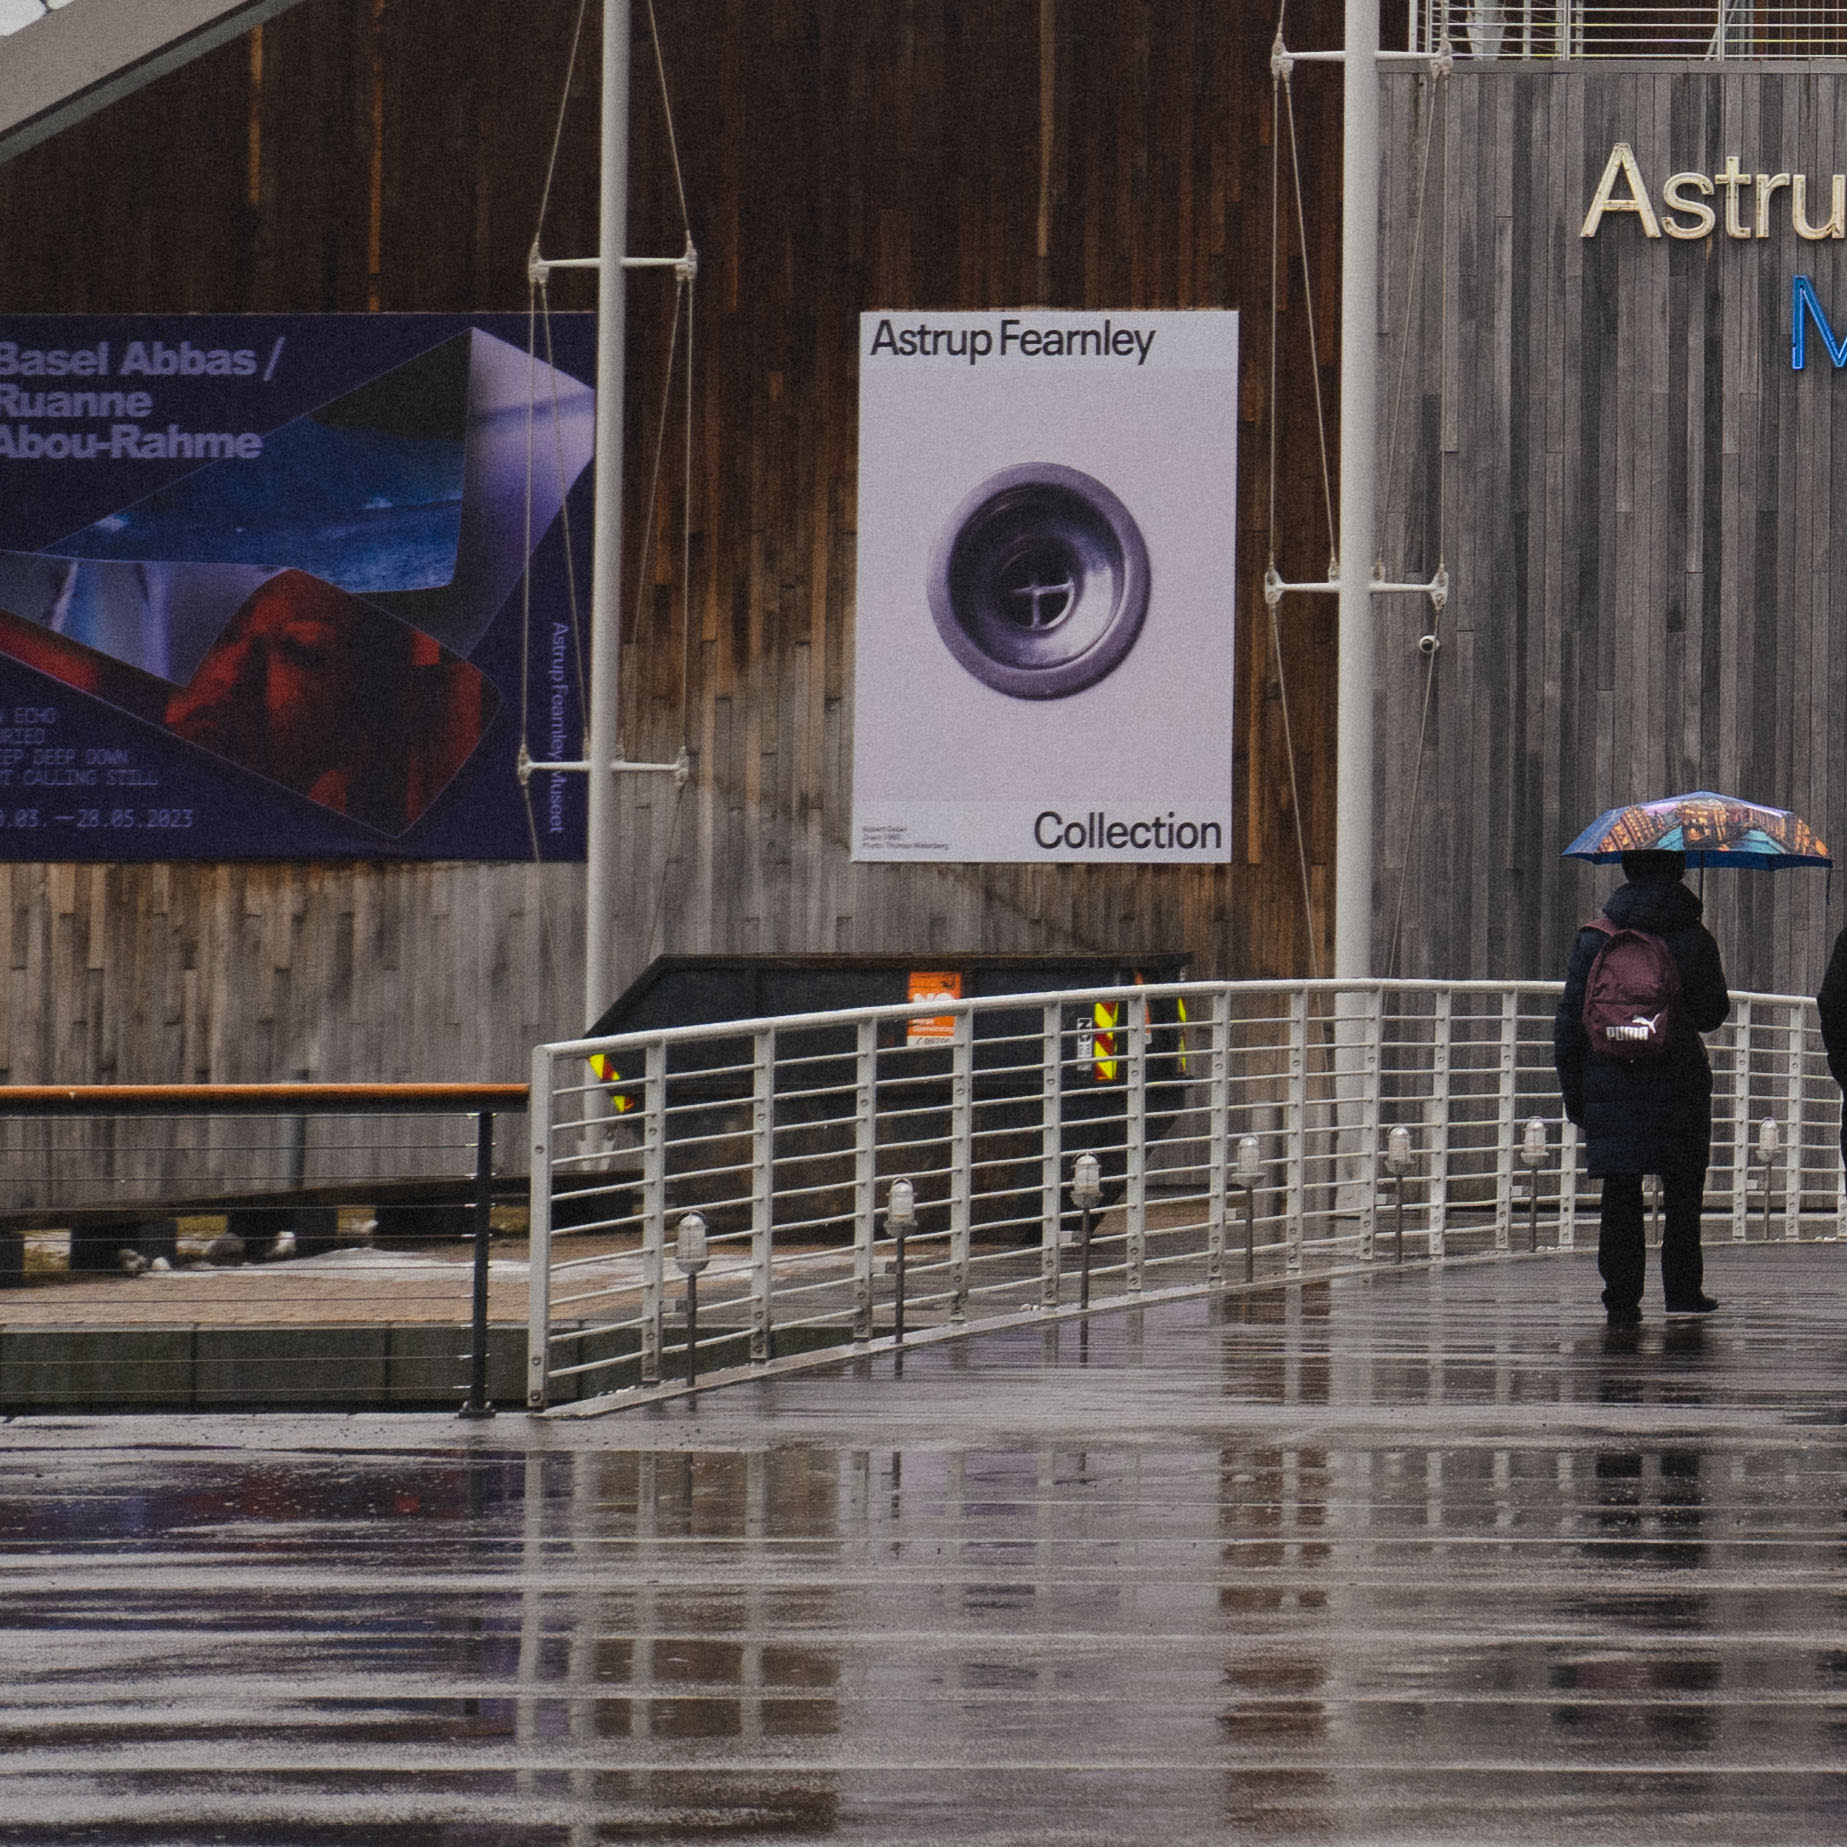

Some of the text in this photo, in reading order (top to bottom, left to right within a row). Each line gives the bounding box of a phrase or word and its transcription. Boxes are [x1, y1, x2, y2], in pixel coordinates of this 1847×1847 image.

[119, 341, 257, 376] Abbas
[871, 319, 1156, 366] Astrup Fearnley
[0, 383, 152, 417] Ruanne
[548, 622, 569, 681] Astrup
[549, 685, 569, 760] Fearnley
[23, 769, 97, 786] CALLING
[1034, 811, 1222, 849] Collection
[1606, 1026, 1649, 1041] PUMA
